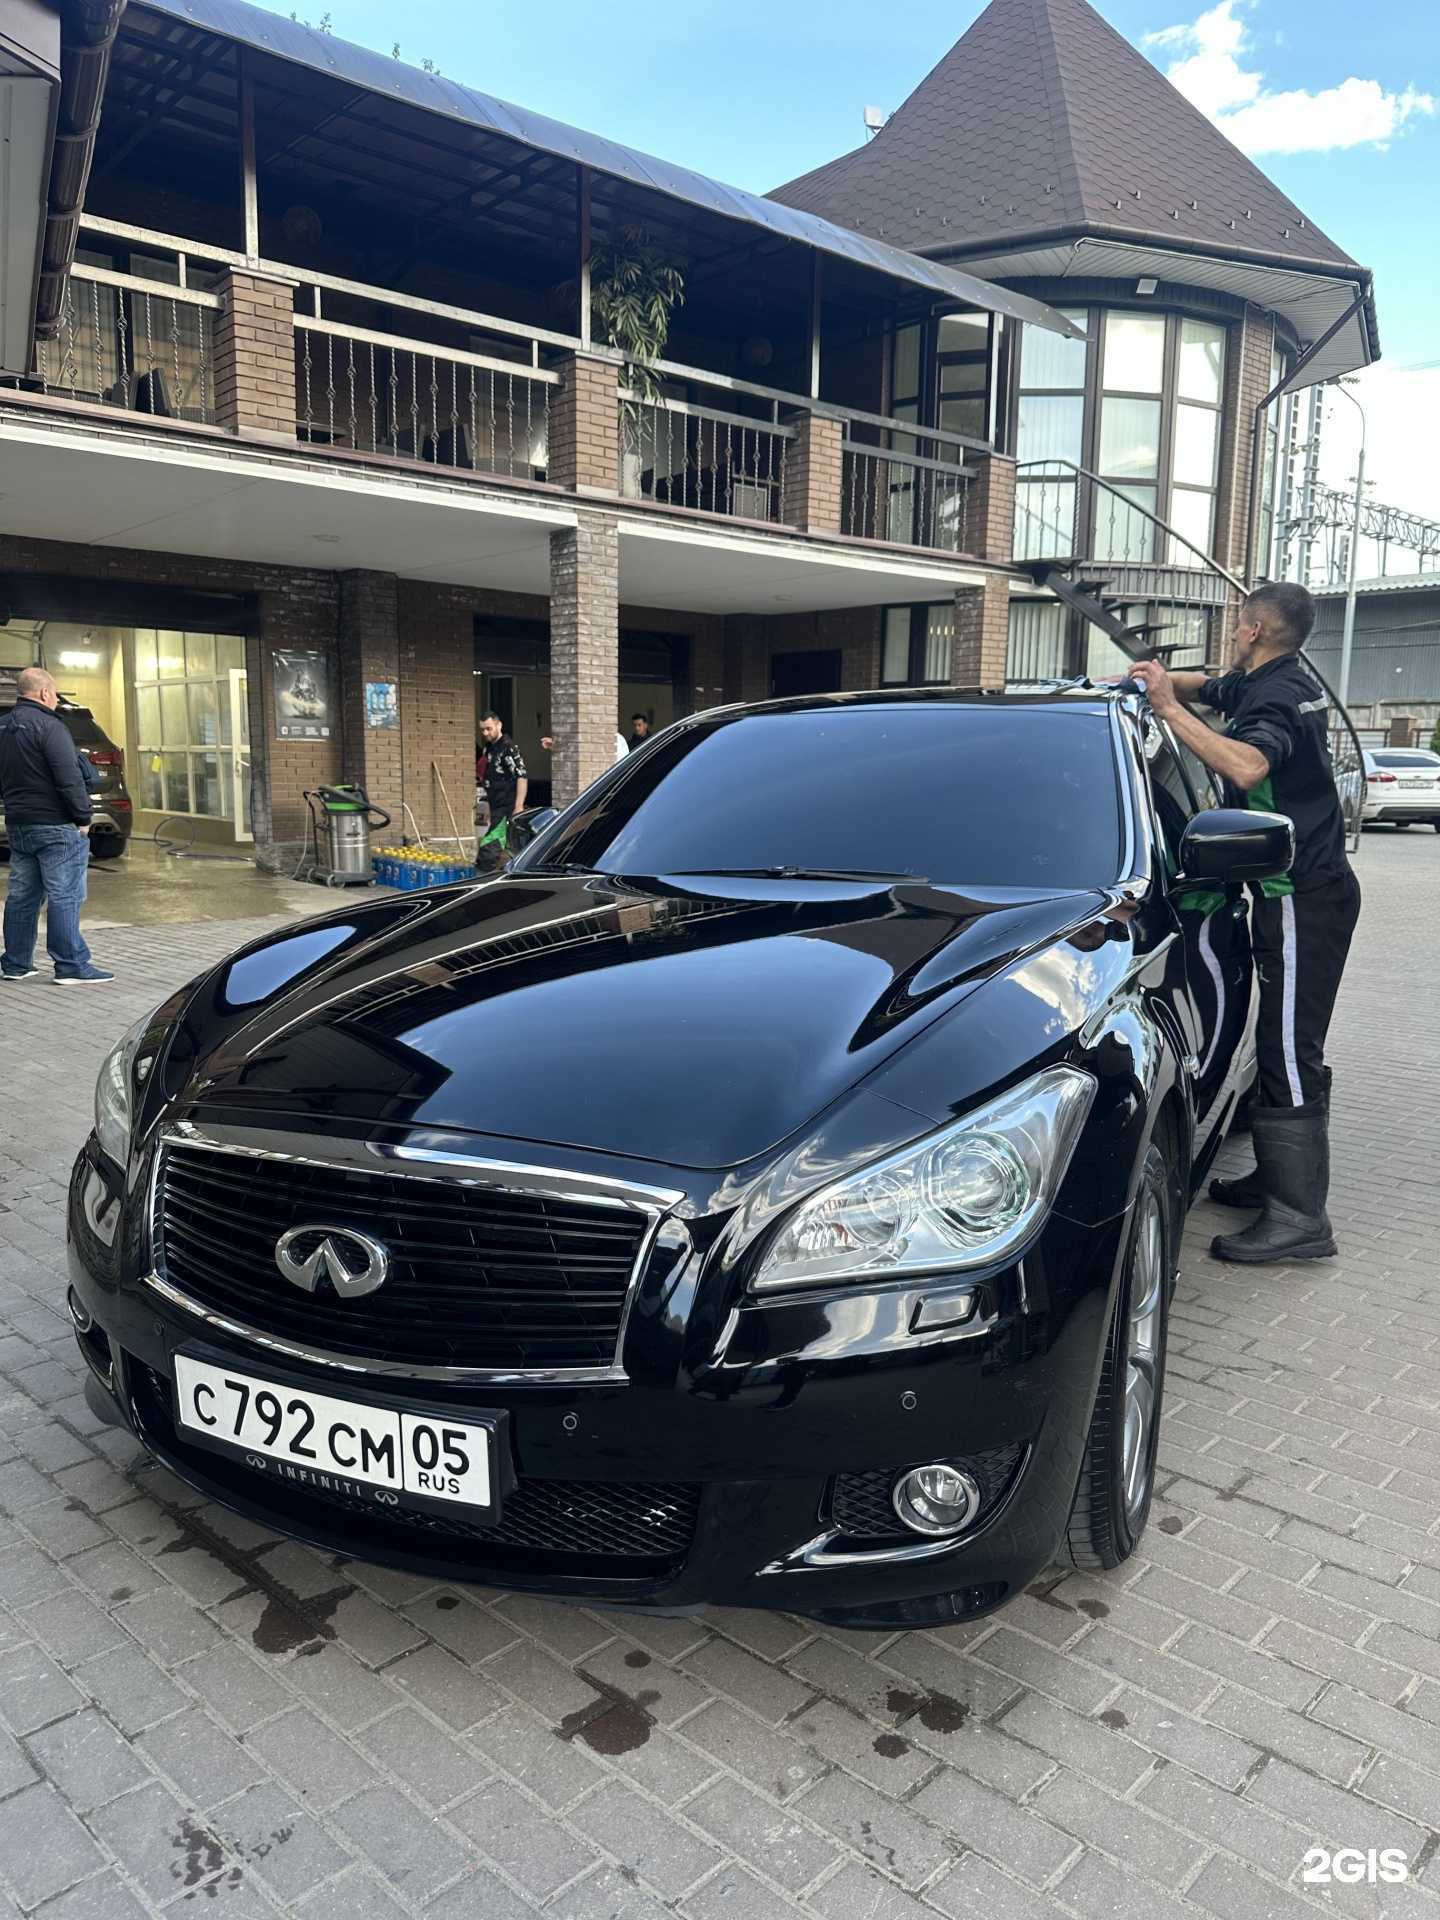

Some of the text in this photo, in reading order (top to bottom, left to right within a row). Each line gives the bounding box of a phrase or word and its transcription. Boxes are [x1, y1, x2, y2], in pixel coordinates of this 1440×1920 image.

[412, 1424, 470, 1475] 05
[277, 1464, 362, 1497] INFINITI
[418, 1472, 461, 1495] RUS
